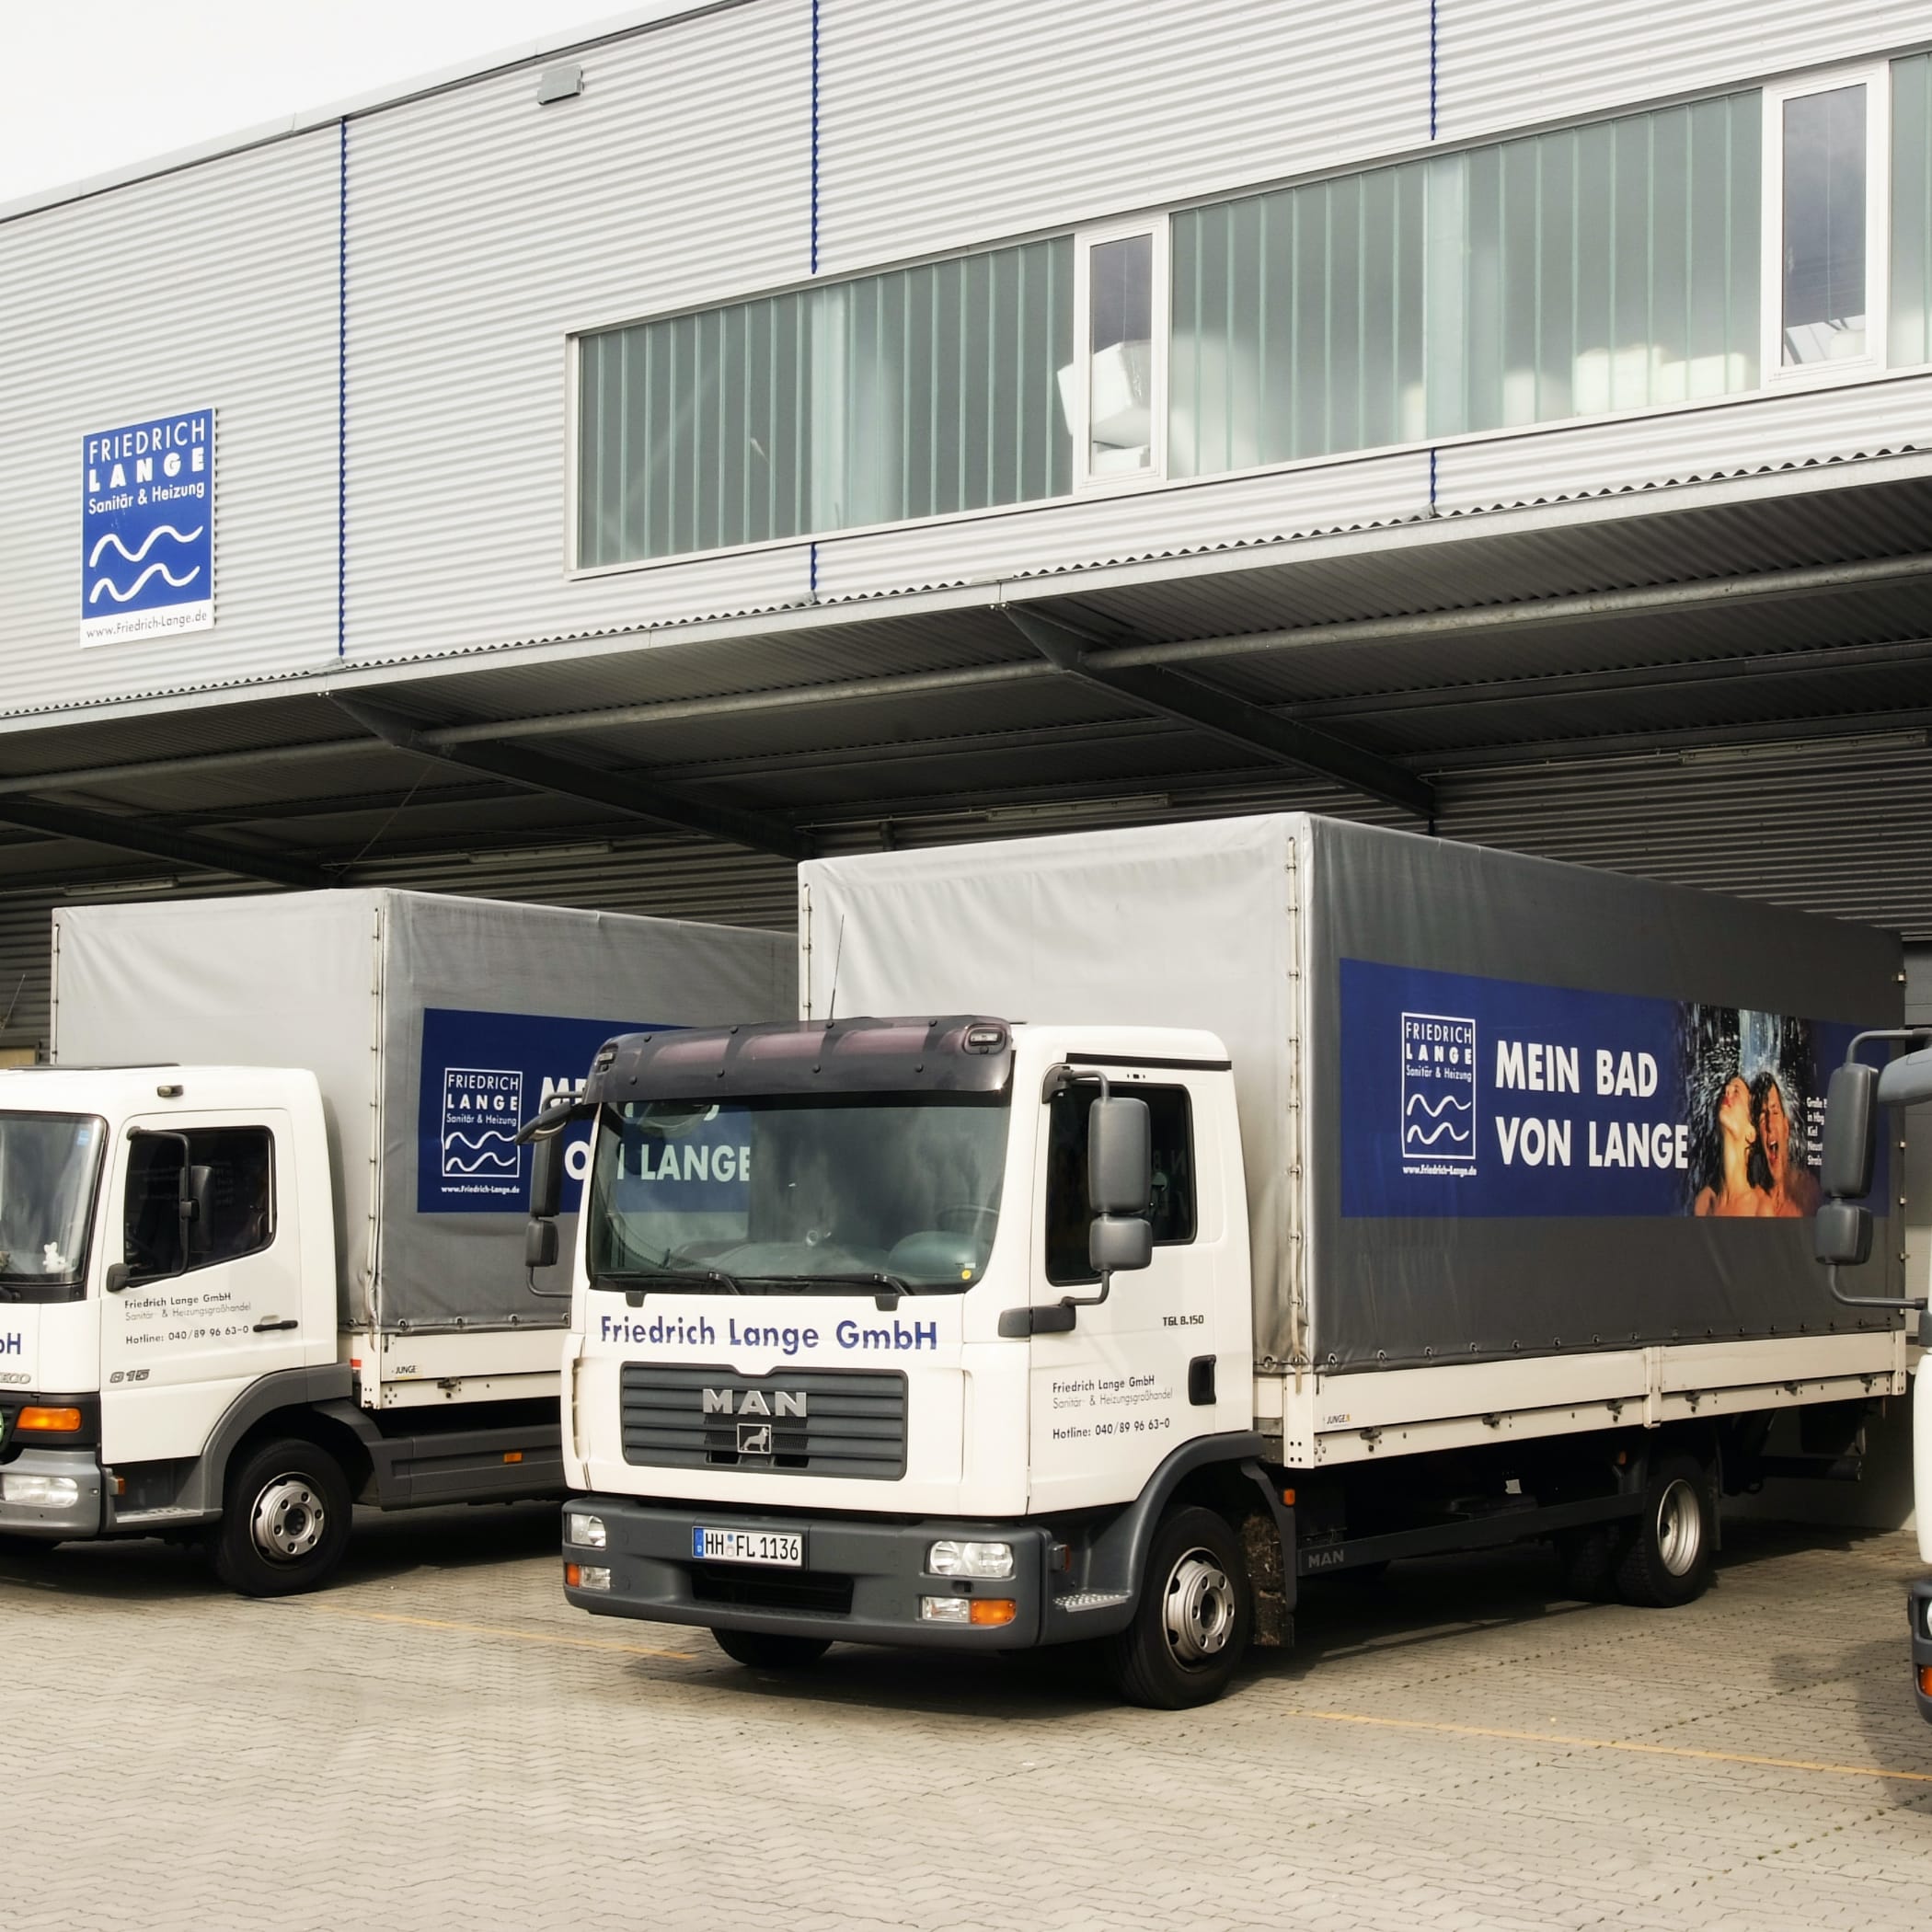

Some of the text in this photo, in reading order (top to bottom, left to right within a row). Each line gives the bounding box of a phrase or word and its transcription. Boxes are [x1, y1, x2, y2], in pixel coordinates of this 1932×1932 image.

[88, 417, 205, 465] FRIEDRICH
[88, 446, 205, 493] LANGE
[88, 481, 205, 515] Sanitär & Heizung
[86, 608, 207, 638] www.Friedrich-Lange.de
[1406, 1022, 1472, 1045] FRIEDRICH
[1406, 1042, 1472, 1065] LANGE
[1406, 1064, 1473, 1083] Sanitär & Heizung
[1495, 1040, 1658, 1098] MEIN BAD
[447, 1075, 520, 1091] FRIEDRICH
[446, 1093, 519, 1111] LANGE
[446, 1112, 517, 1127] Sanitär & Heizung
[1495, 1116, 1689, 1169] VON LANGE
[640, 1143, 751, 1182] LANGE
[124, 1292, 232, 1310] Friedrich Lange GmbH
[162, 1308, 168, 1319] &
[172, 1301, 251, 1318] Heizungsgroßhandel
[1179, 1314, 1204, 1326] 8.150
[126, 1326, 249, 1346] Hotline: 040/89 96 63-0
[601, 1316, 937, 1355] Friedrich Lange GmbH
[396, 1364, 417, 1374] JUNGE
[1052, 1374, 1156, 1394] Friedrich Lange GmbH
[702, 1387, 808, 1418] MAN
[1089, 1395, 1097, 1407] &
[1099, 1386, 1174, 1407] Heizungsgroßhandel
[1052, 1417, 1171, 1440] Hotline: 040/89 96 63-0
[1327, 1413, 1347, 1425] JUNGE
[705, 1533, 799, 1561] HH FL 1136
[1308, 1548, 1345, 1569] MAN
